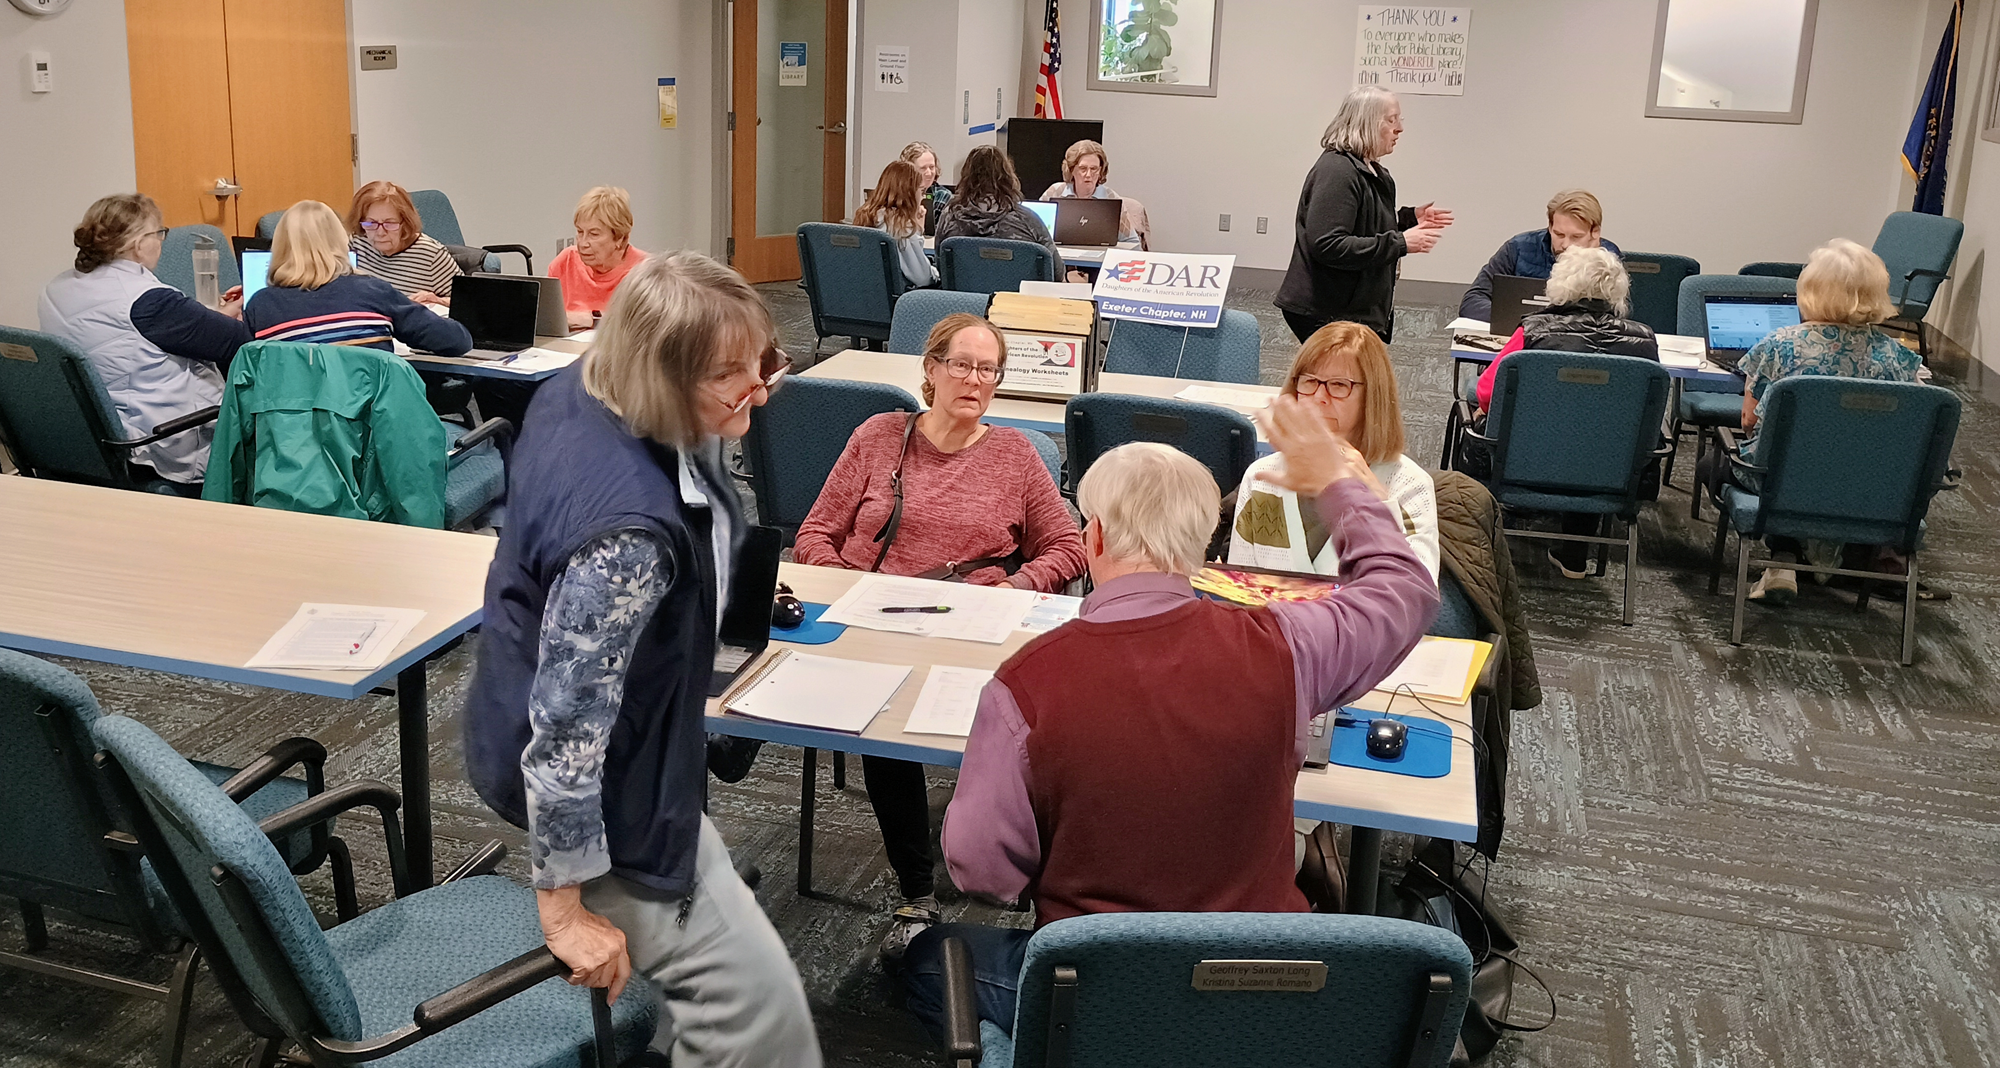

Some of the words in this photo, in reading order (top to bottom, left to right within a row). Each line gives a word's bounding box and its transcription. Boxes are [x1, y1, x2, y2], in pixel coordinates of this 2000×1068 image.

[1377, 8, 1419, 26] THANK
[1422, 9, 1446, 26] YOU
[1362, 28, 1372, 40] To
[1375, 30, 1415, 42] everyone
[1418, 30, 1436, 42] who
[1438, 32, 1464, 44] makes
[1366, 41, 1381, 55] the
[1384, 41, 1406, 55] Exeter
[1409, 42, 1430, 56] Public
[1431, 44, 1462, 60] Library
[1386, 69, 1416, 84] Thank
[1143, 262, 1220, 289] DAR
[1102, 282, 1132, 292] Daughters
[1102, 301, 1137, 314] Exeter
[1140, 306, 1187, 320] Chapter,
[1190, 310, 1208, 320] NH
[1031, 368, 1069, 376] Worksheets
[1209, 966, 1250, 976] Geoffrey
[1252, 966, 1284, 975] Saxton
[1288, 966, 1310, 976] Long
[1202, 978, 1235, 987] Kristina
[1238, 978, 1274, 987] Suzanne
[1276, 978, 1312, 988] Romano
